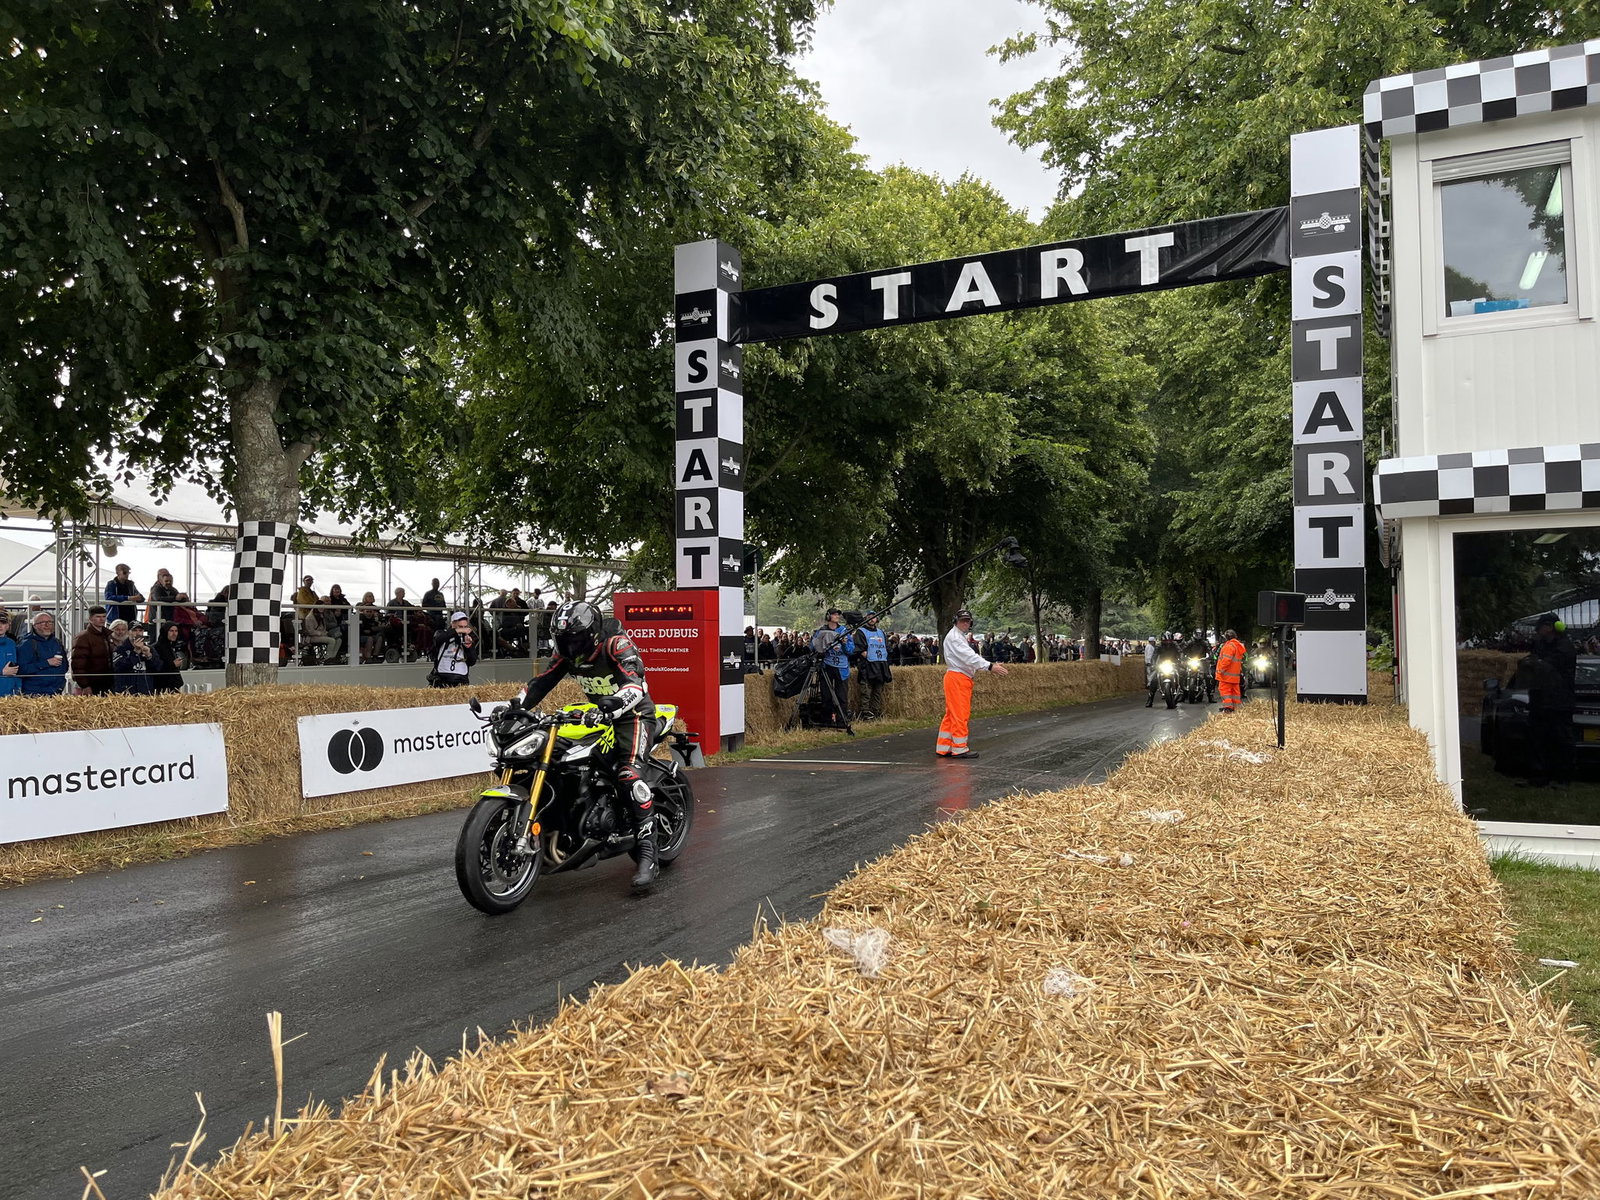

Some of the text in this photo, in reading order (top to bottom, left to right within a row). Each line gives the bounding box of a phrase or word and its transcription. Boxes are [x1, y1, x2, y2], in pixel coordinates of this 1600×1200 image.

[809, 231, 1175, 330] START
[1302, 265, 1356, 560] START
[682, 349, 714, 580] START
[625, 628, 699, 638] OGER DUBUIS
[450, 659, 456, 672] 8
[394, 728, 488, 755] mastercar
[8, 754, 196, 800] mastercard
